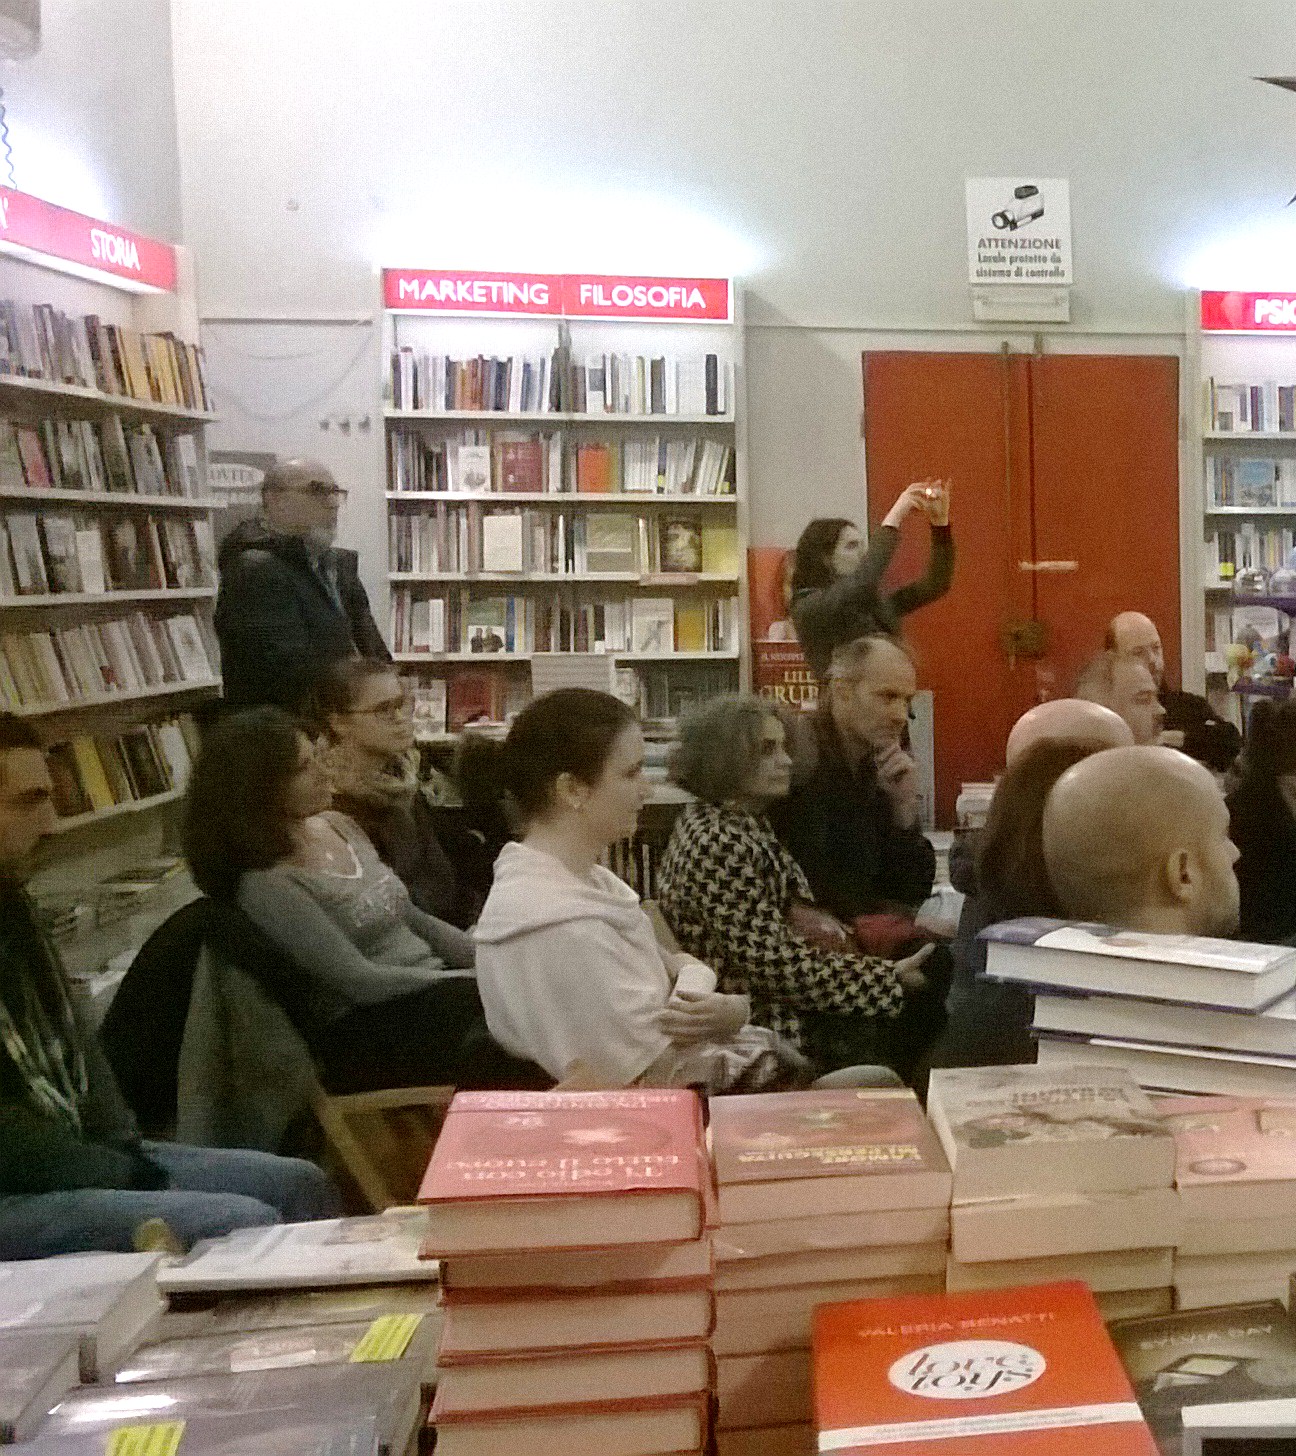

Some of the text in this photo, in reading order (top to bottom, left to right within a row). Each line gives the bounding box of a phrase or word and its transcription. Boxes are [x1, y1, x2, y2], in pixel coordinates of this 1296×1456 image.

[90, 228, 140, 271] STORIA
[978, 238, 1062, 250] ATTENZIONE
[978, 252, 1062, 266] Locale protetto da
[976, 266, 1065, 278] sistema di controllo
[398, 278, 550, 305] MARKETING
[579, 283, 707, 309] FILOSOFIA
[784, 670, 817, 683] LILL
[858, 1312, 1056, 1337] VALERIA BENATTI
